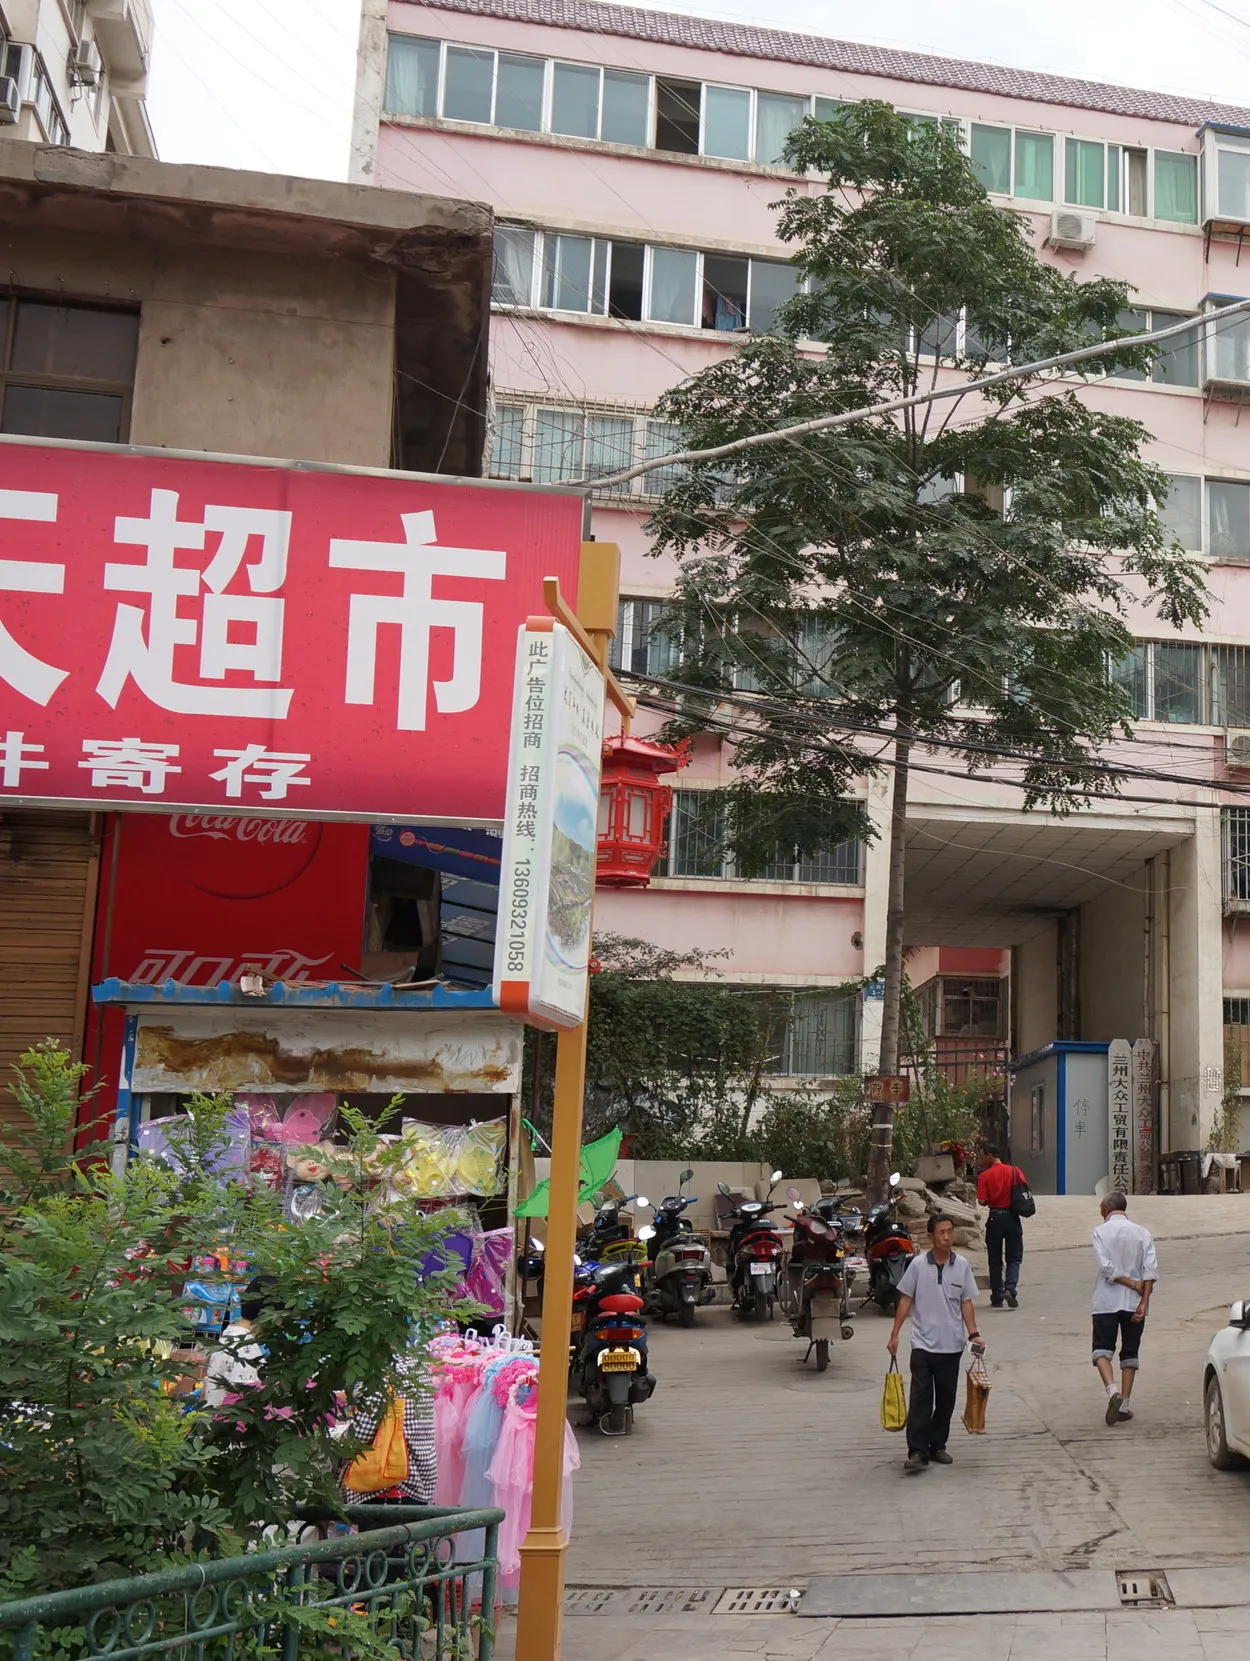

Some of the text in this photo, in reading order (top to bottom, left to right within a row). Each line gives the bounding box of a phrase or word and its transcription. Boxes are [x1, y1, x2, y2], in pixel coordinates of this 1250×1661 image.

[522, 641, 549, 749] 此广告位招商
[507, 858, 532, 973] 13609321058
